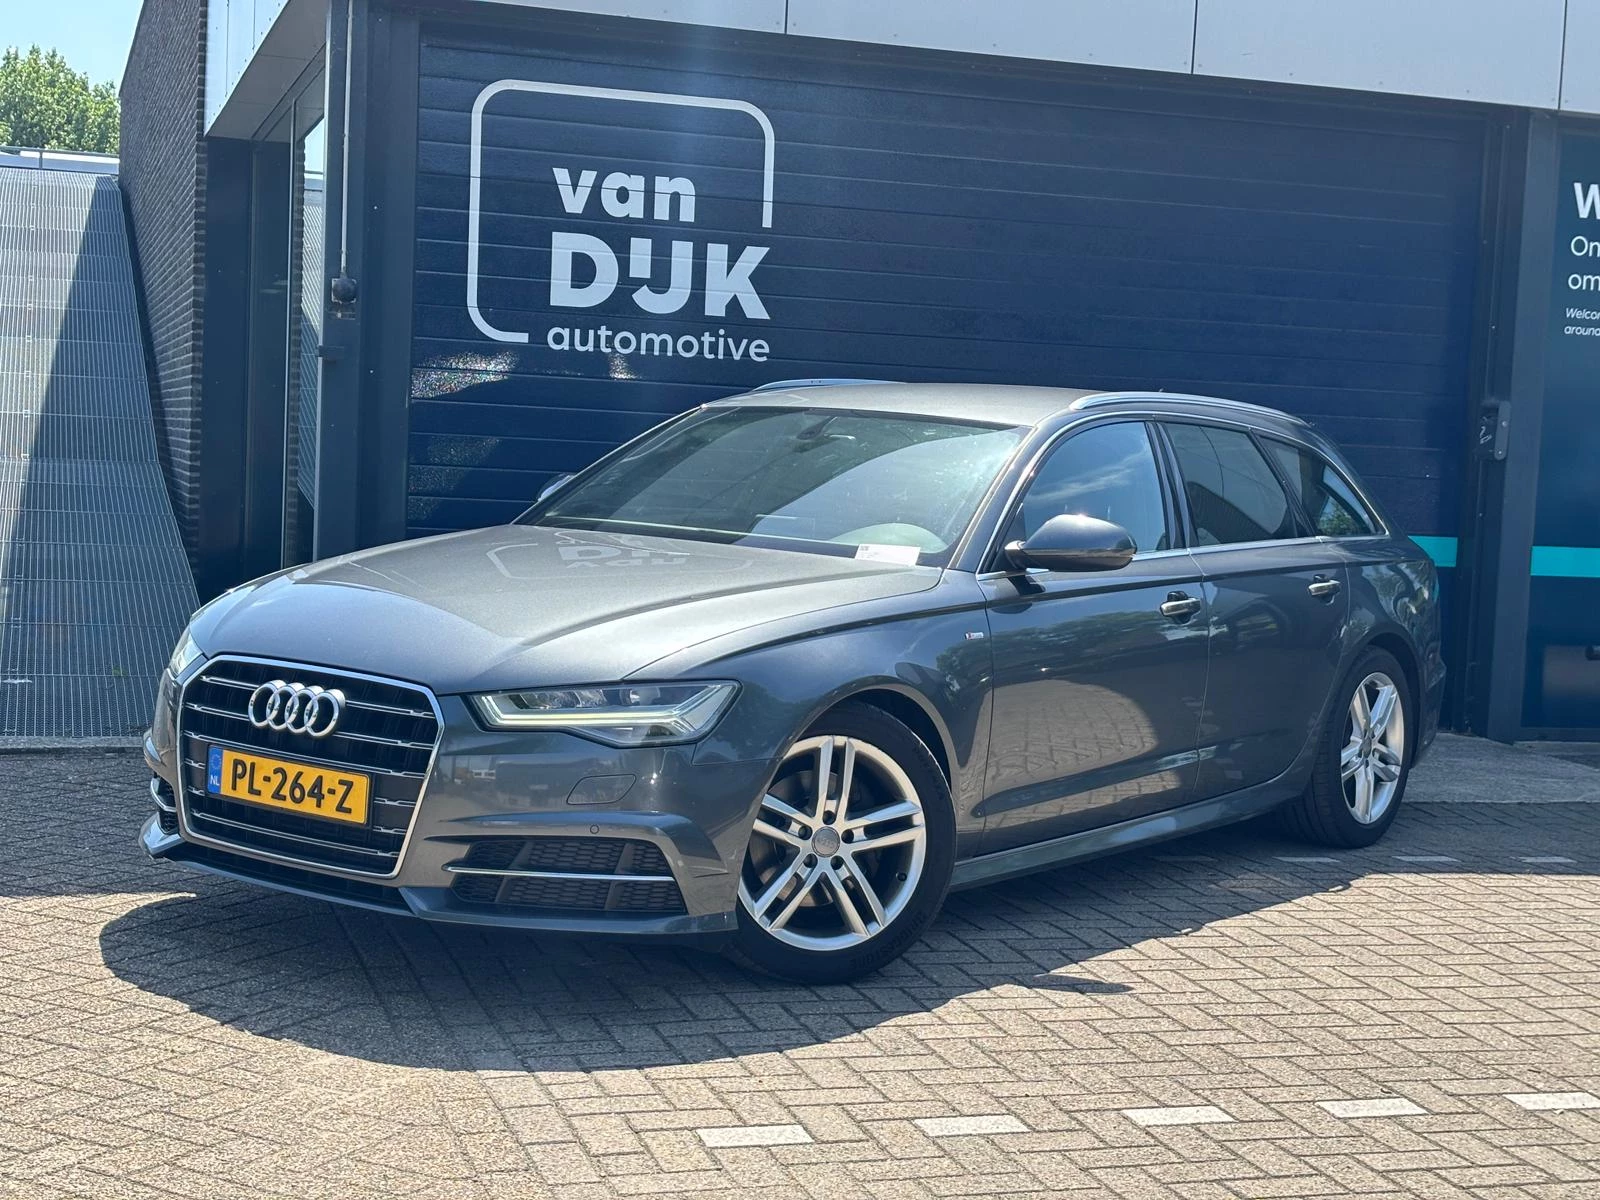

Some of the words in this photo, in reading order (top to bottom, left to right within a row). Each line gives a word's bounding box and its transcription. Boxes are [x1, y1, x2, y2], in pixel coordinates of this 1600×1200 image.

[552, 167, 696, 223] van
[550, 231, 770, 320] DIJK
[547, 324, 770, 362] automotive
[210, 774, 220, 787] NL
[231, 758, 354, 814] PL-264-Z
